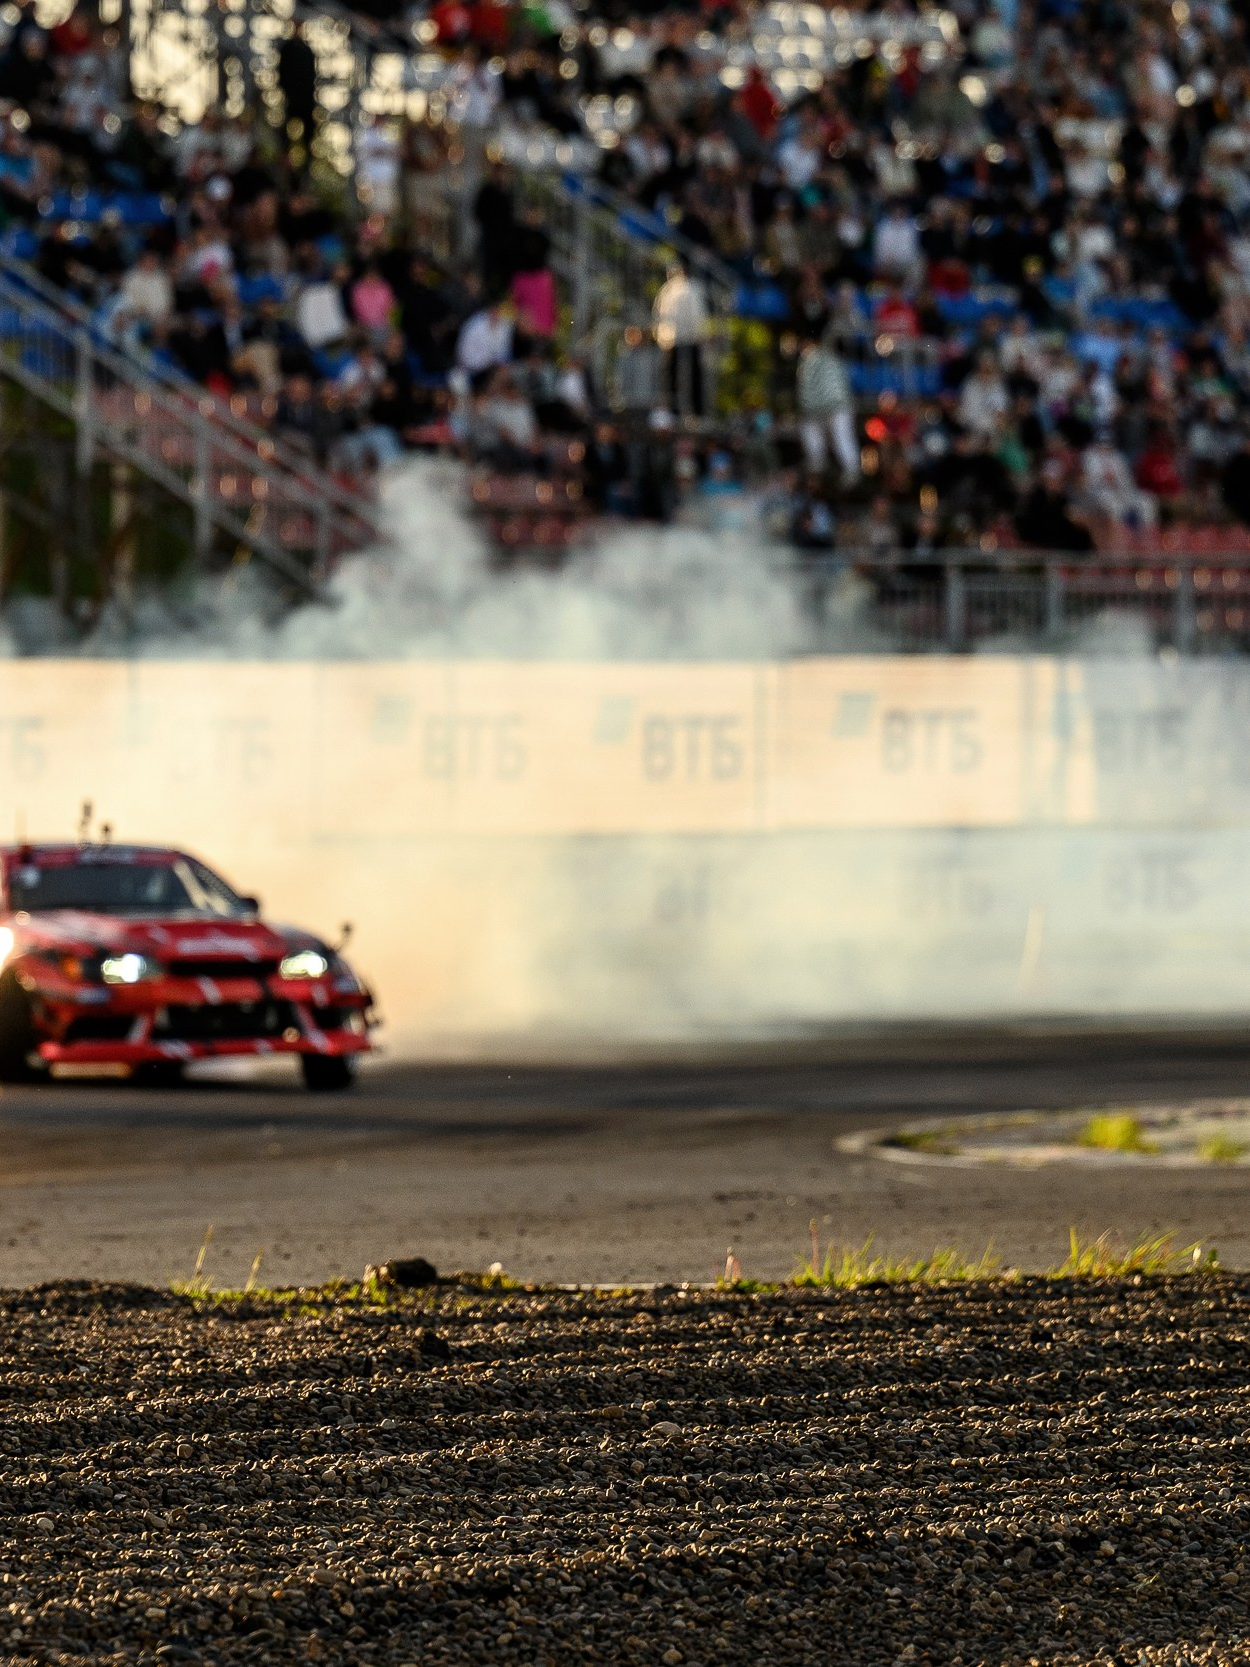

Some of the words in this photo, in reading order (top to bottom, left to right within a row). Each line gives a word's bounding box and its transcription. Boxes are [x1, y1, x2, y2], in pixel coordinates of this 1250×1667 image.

[170, 715, 274, 783] ТБ
[423, 714, 529, 782] ВТБ
[643, 714, 744, 782] ВТБ
[881, 708, 985, 774] ВТБ
